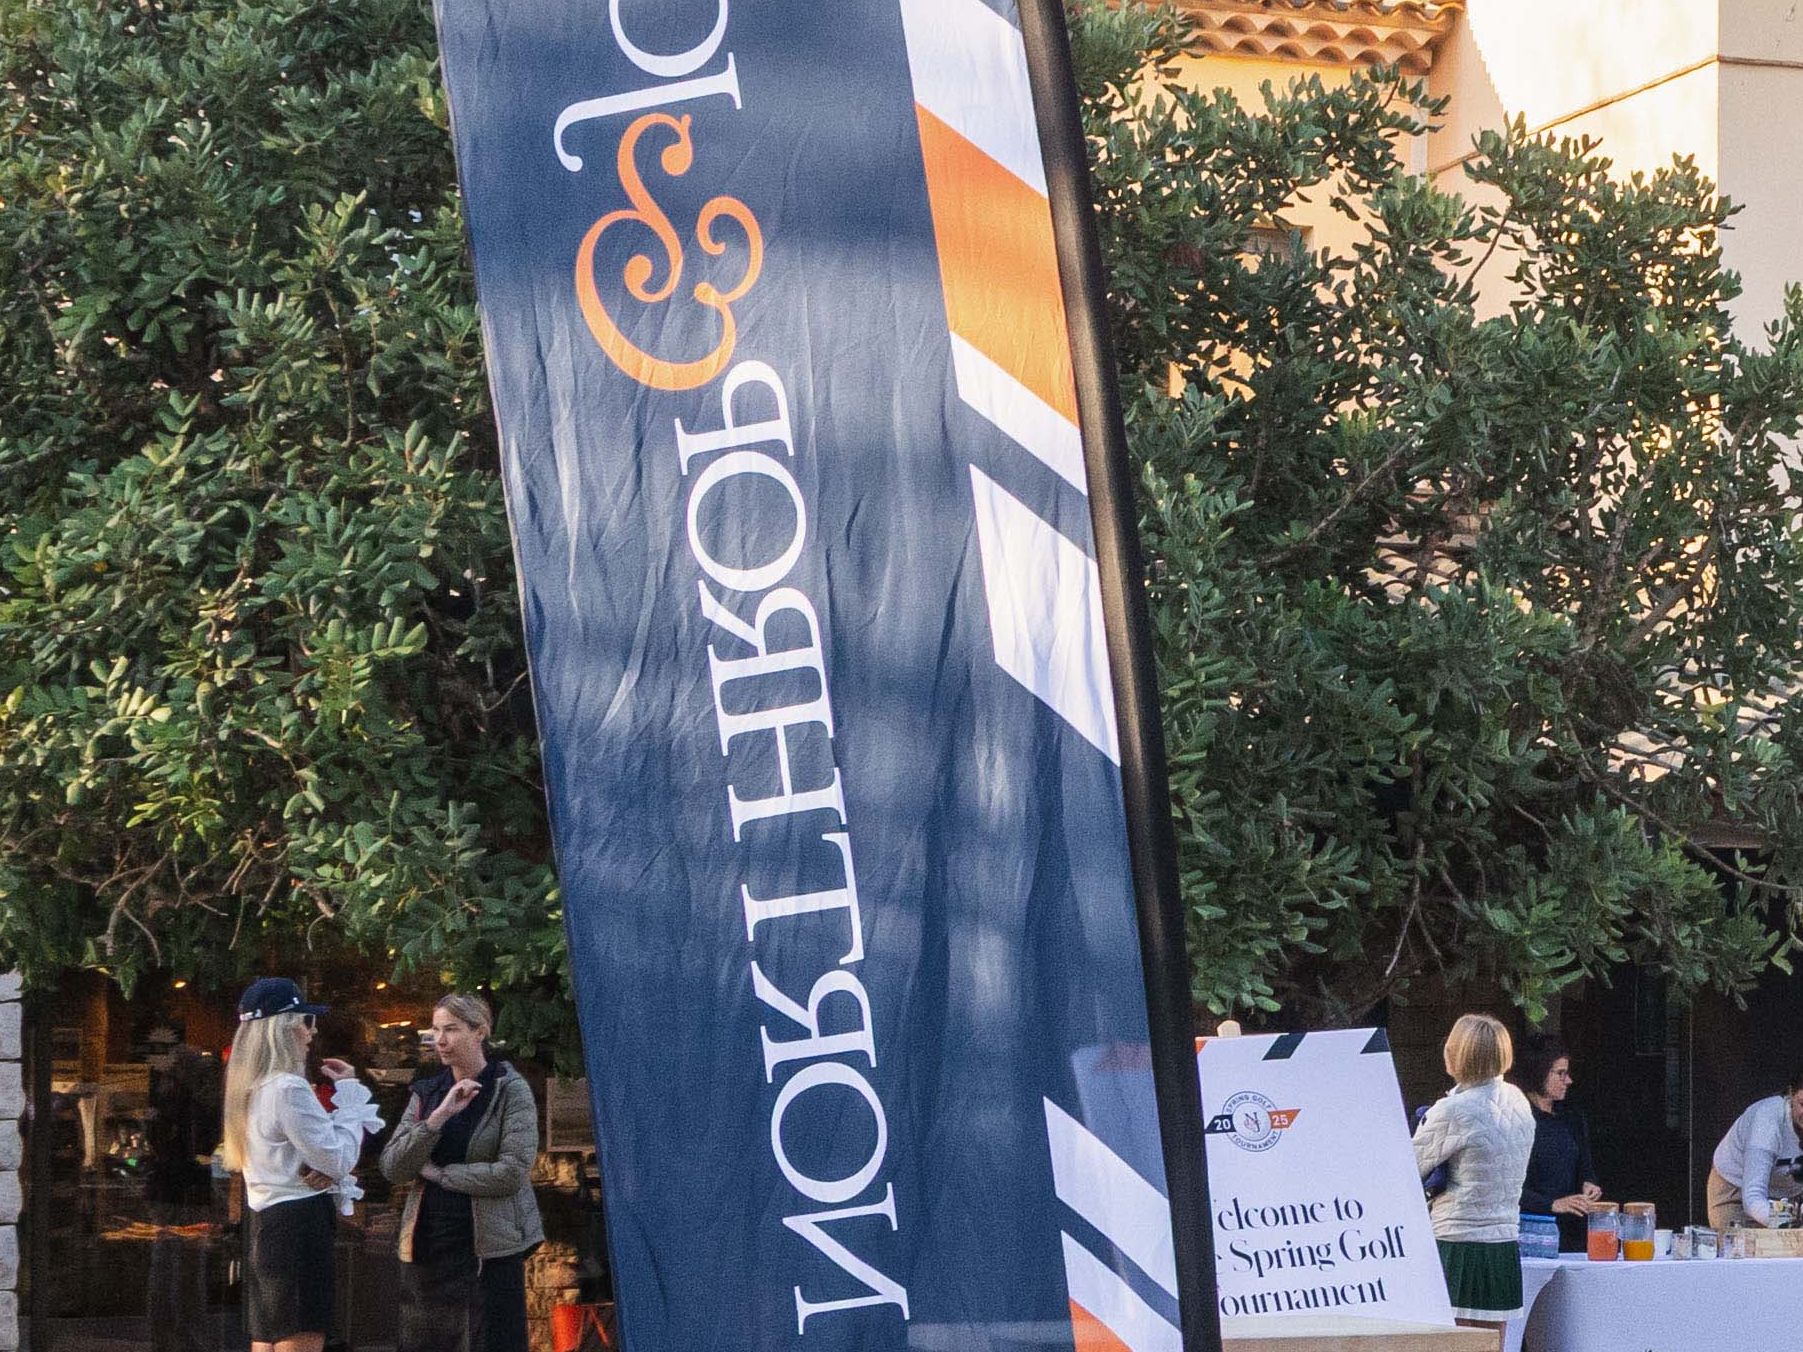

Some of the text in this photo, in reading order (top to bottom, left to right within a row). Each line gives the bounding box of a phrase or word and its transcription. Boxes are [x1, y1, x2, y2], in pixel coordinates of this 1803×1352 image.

[1226, 1094, 1272, 1113] SPRING GOLF
[1214, 1118, 1231, 1130] 20
[1271, 1114, 1289, 1126] 25
[1231, 1130, 1279, 1149] TOURNAMENT
[1216, 1196, 1364, 1232] elcome to
[1229, 1239, 1336, 1278] Spring
[1339, 1225, 1406, 1262] Golf
[1220, 1276, 1388, 1318] ournament
